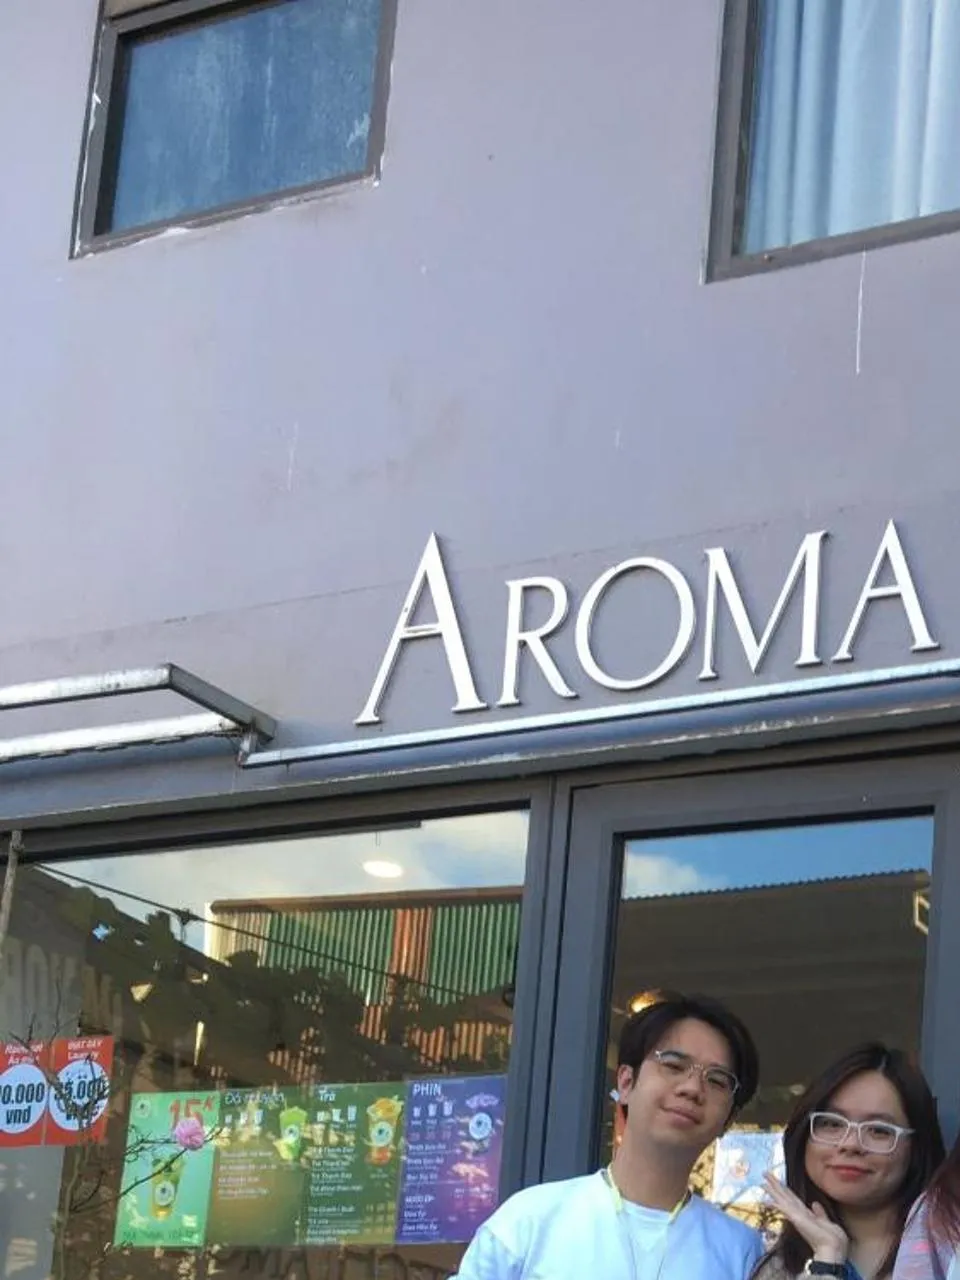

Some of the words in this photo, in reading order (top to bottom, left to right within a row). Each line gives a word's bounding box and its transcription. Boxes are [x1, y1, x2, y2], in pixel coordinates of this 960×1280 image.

[353, 518, 939, 725] AROMA
[0, 1083, 45, 1104] 0.000
[6, 1106, 32, 1124] vnd
